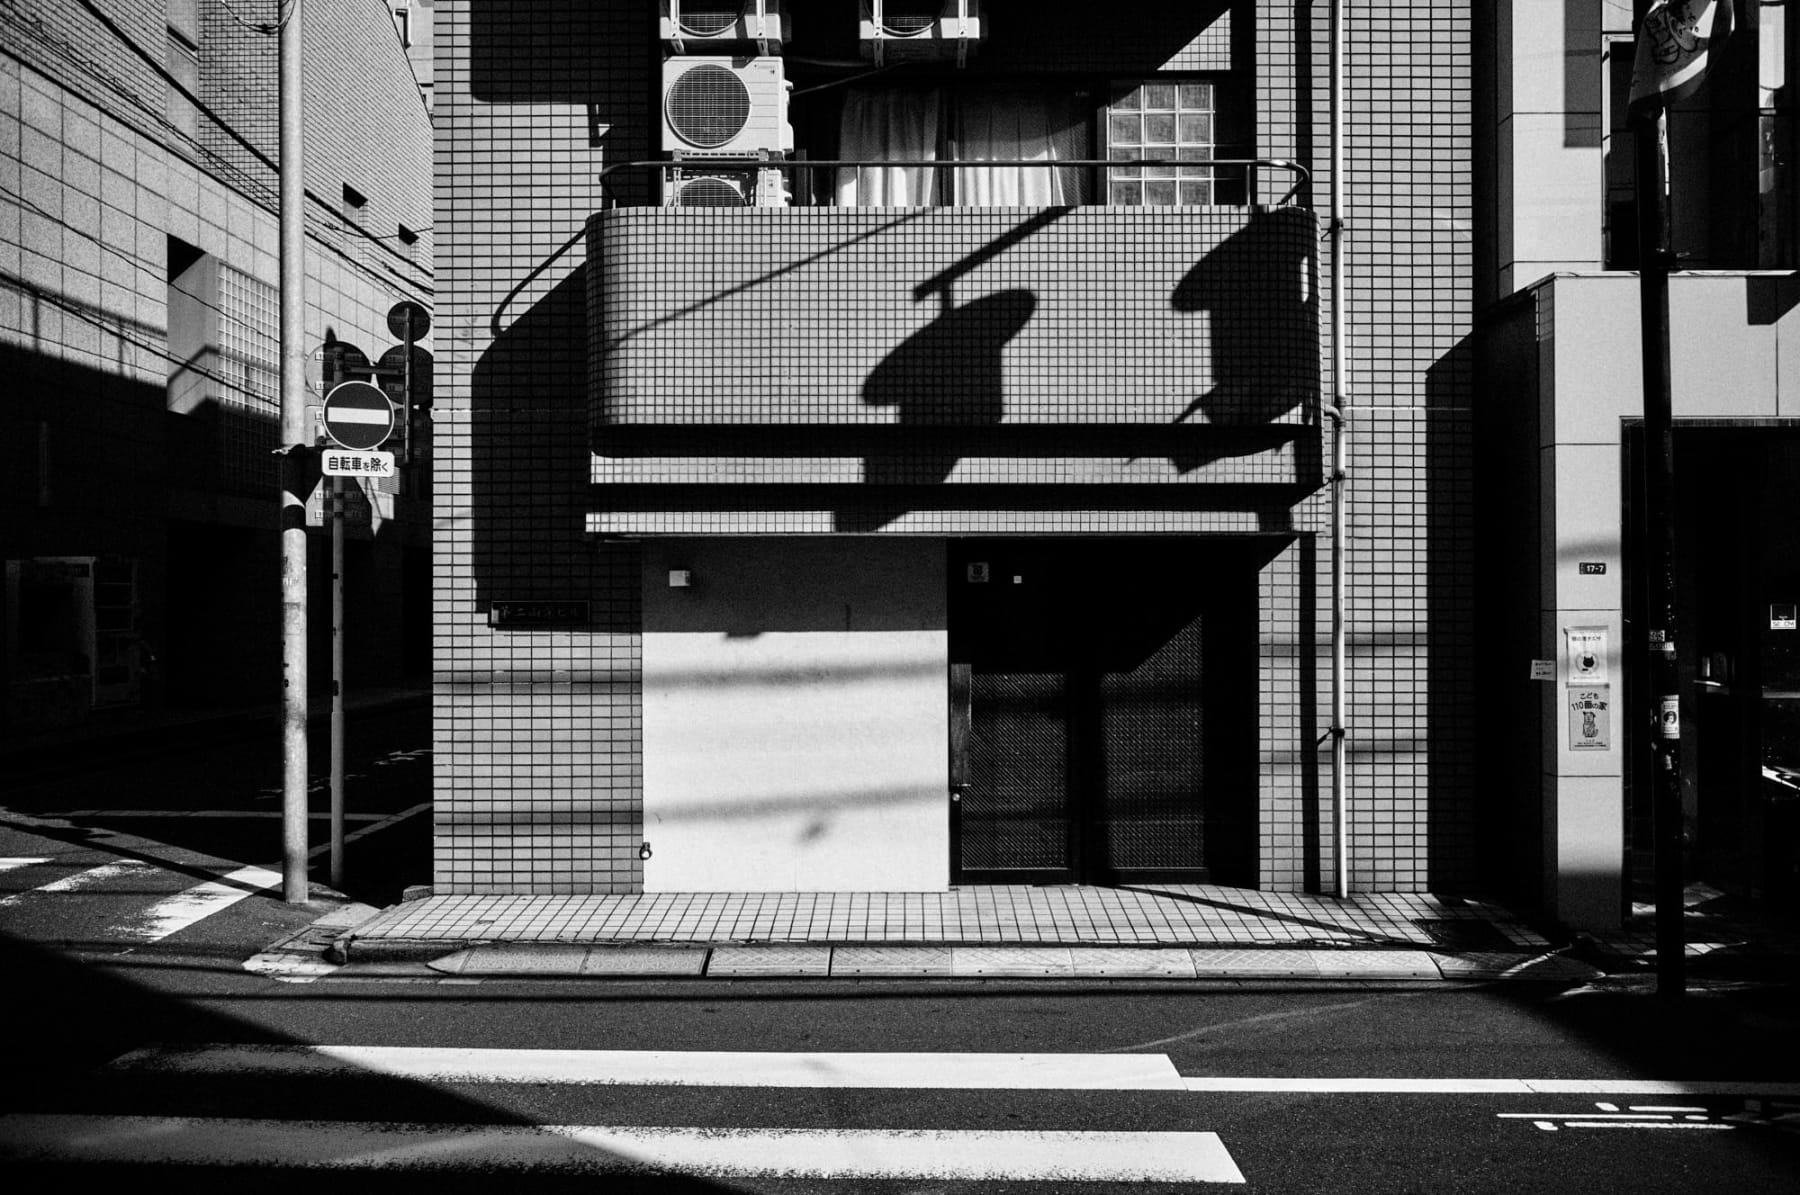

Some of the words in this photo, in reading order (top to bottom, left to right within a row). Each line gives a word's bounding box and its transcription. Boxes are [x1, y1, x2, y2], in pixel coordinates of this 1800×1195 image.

[328, 456, 388, 472] 自転車を除く
[1586, 565, 1604, 573] 17-7
[1580, 692, 1599, 700] こども
